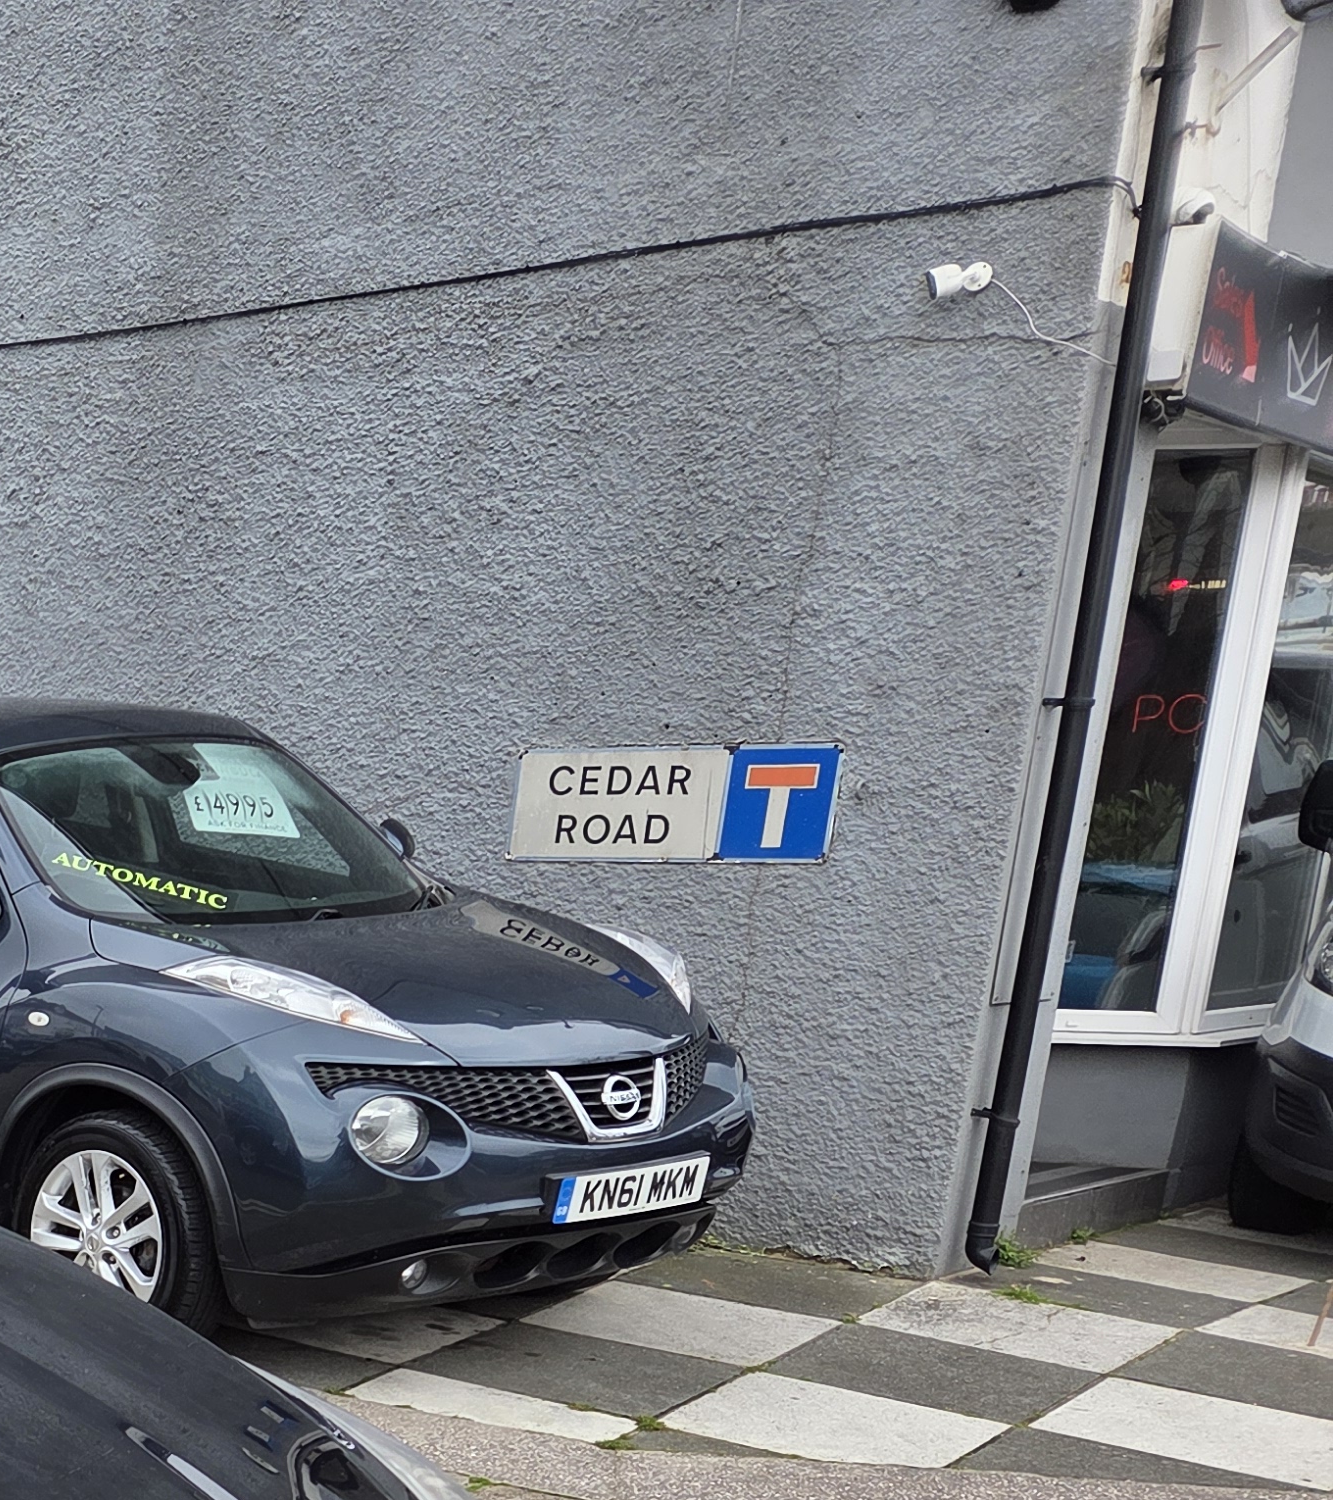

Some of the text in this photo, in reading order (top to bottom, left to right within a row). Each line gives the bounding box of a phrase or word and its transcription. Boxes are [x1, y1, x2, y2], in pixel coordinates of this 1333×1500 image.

[549, 765, 692, 796] CEDAR
[555, 814, 671, 844] ROAD
[51, 852, 228, 910] AUTOMATIC
[579, 1164, 699, 1214] KN61 MKM
